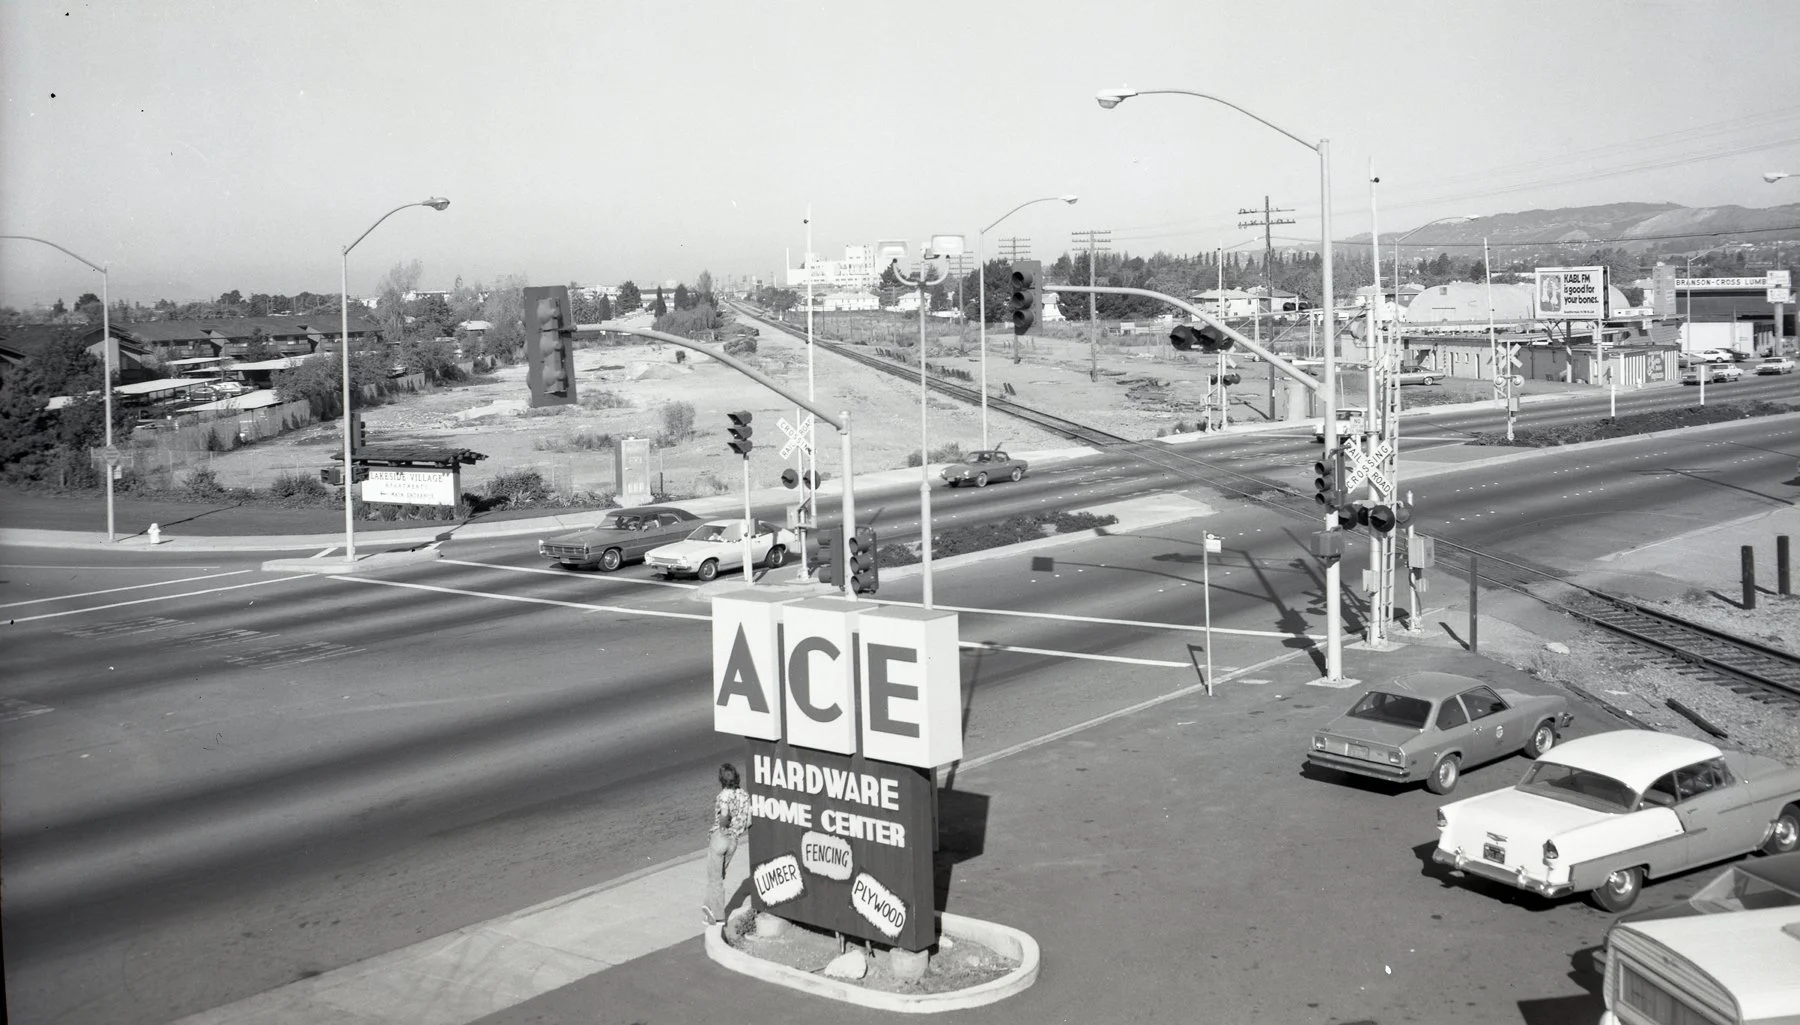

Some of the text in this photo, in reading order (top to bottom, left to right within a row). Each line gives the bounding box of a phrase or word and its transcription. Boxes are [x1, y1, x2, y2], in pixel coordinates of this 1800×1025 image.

[1563, 273, 1591, 283] KABL FM
[1563, 284, 1595, 296] is good for
[1675, 278, 1741, 286] BRANSON-CROSS
[1563, 294, 1599, 306] your bones.
[370, 472, 443, 483] LAKESIDE VILLAGE
[1346, 445, 1389, 489] CROSSING
[1372, 471, 1391, 493] ROAD
[716, 621, 920, 739] ACE
[754, 754, 899, 811] HARDWARE
[750, 794, 906, 848] HOME CENTER
[805, 843, 849, 868] FENCING
[755, 864, 798, 895] LUMBER
[855, 882, 905, 929] PLYWOOD
